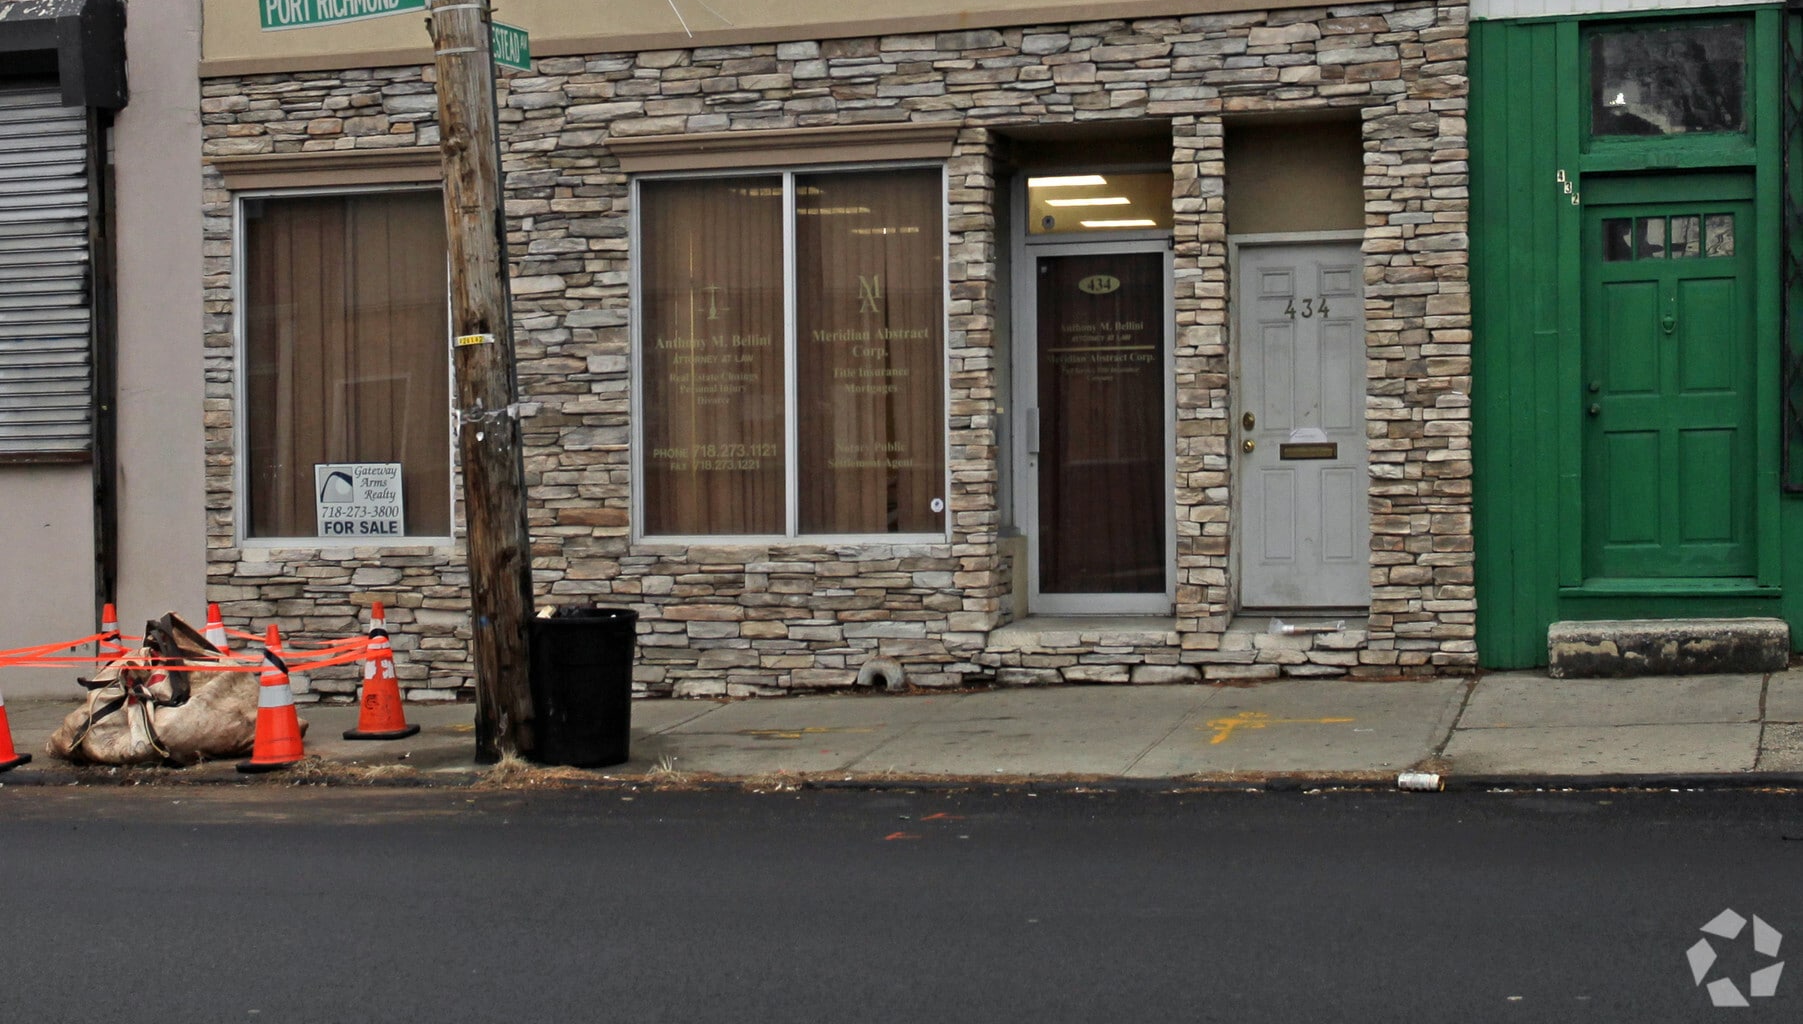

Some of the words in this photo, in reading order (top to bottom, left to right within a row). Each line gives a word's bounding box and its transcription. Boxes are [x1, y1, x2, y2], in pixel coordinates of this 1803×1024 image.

[1087, 278, 1111, 291] 434
[1284, 298, 1330, 319] 434
[712, 336, 727, 348] M.
[732, 334, 772, 347] Bellini
[812, 329, 870, 342] Meridian
[875, 327, 929, 340] Abstract
[852, 345, 888, 360] Corp.
[354, 466, 397, 479] Gateway
[360, 478, 387, 487] Arms
[364, 488, 396, 503] Realty
[322, 506, 399, 518] 718-273-3800
[324, 521, 354, 534] FOR
[360, 521, 398, 534] SALE
